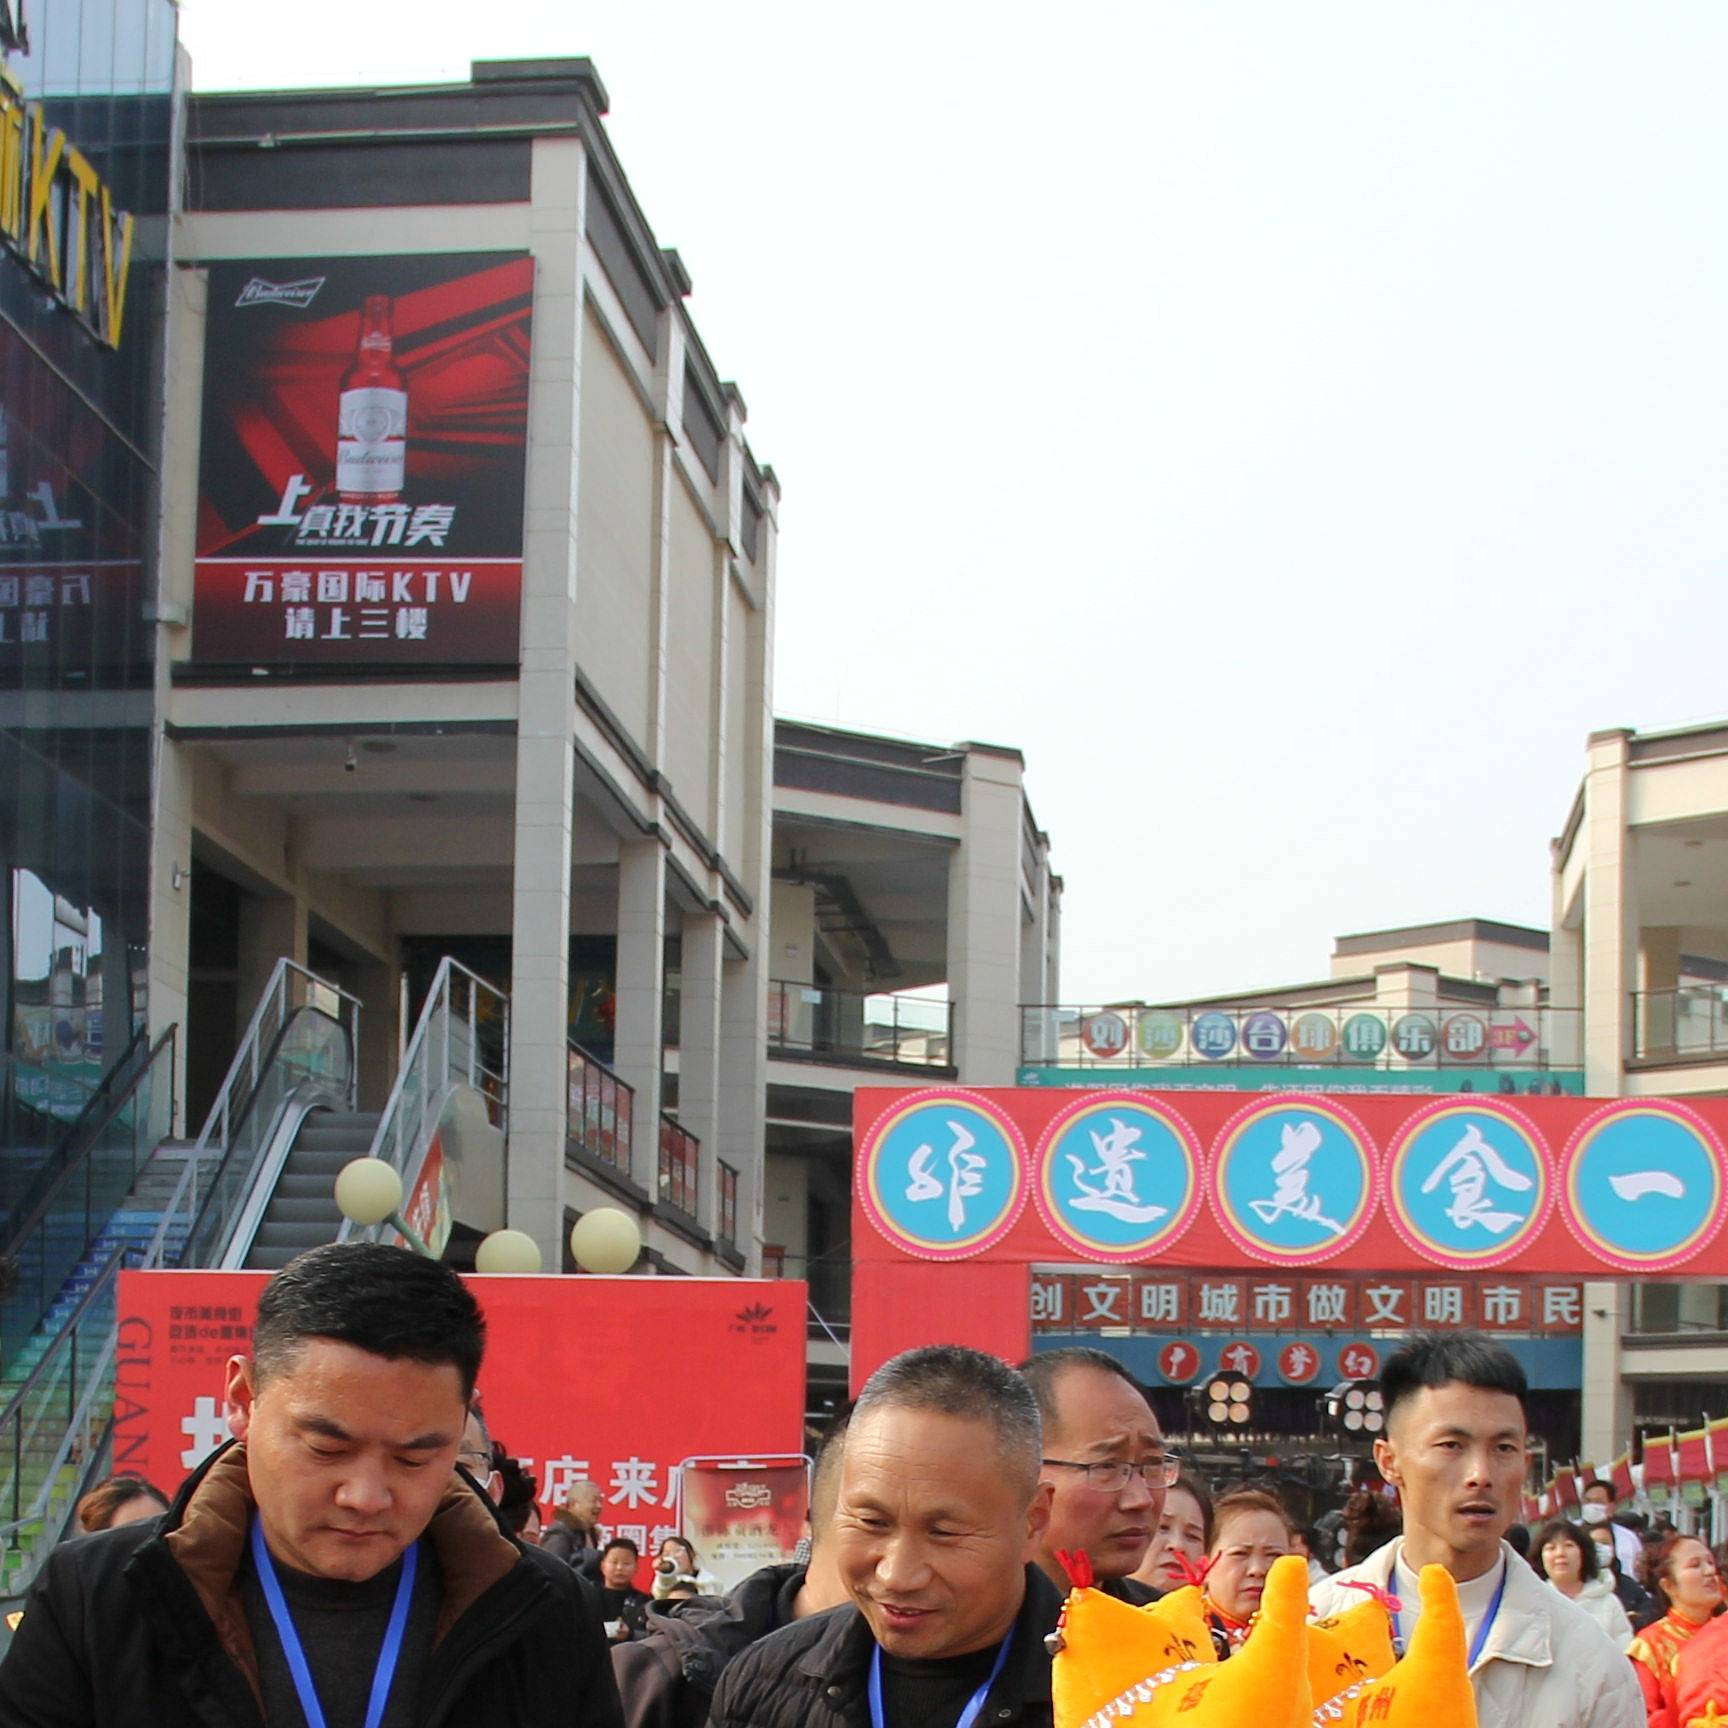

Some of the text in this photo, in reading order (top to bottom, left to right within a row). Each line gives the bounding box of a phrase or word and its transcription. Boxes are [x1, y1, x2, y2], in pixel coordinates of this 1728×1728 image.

[243, 570, 472, 603] 万豪国际KTV
[1030, 1283, 1582, 1325] 创文明城市做文明市民
